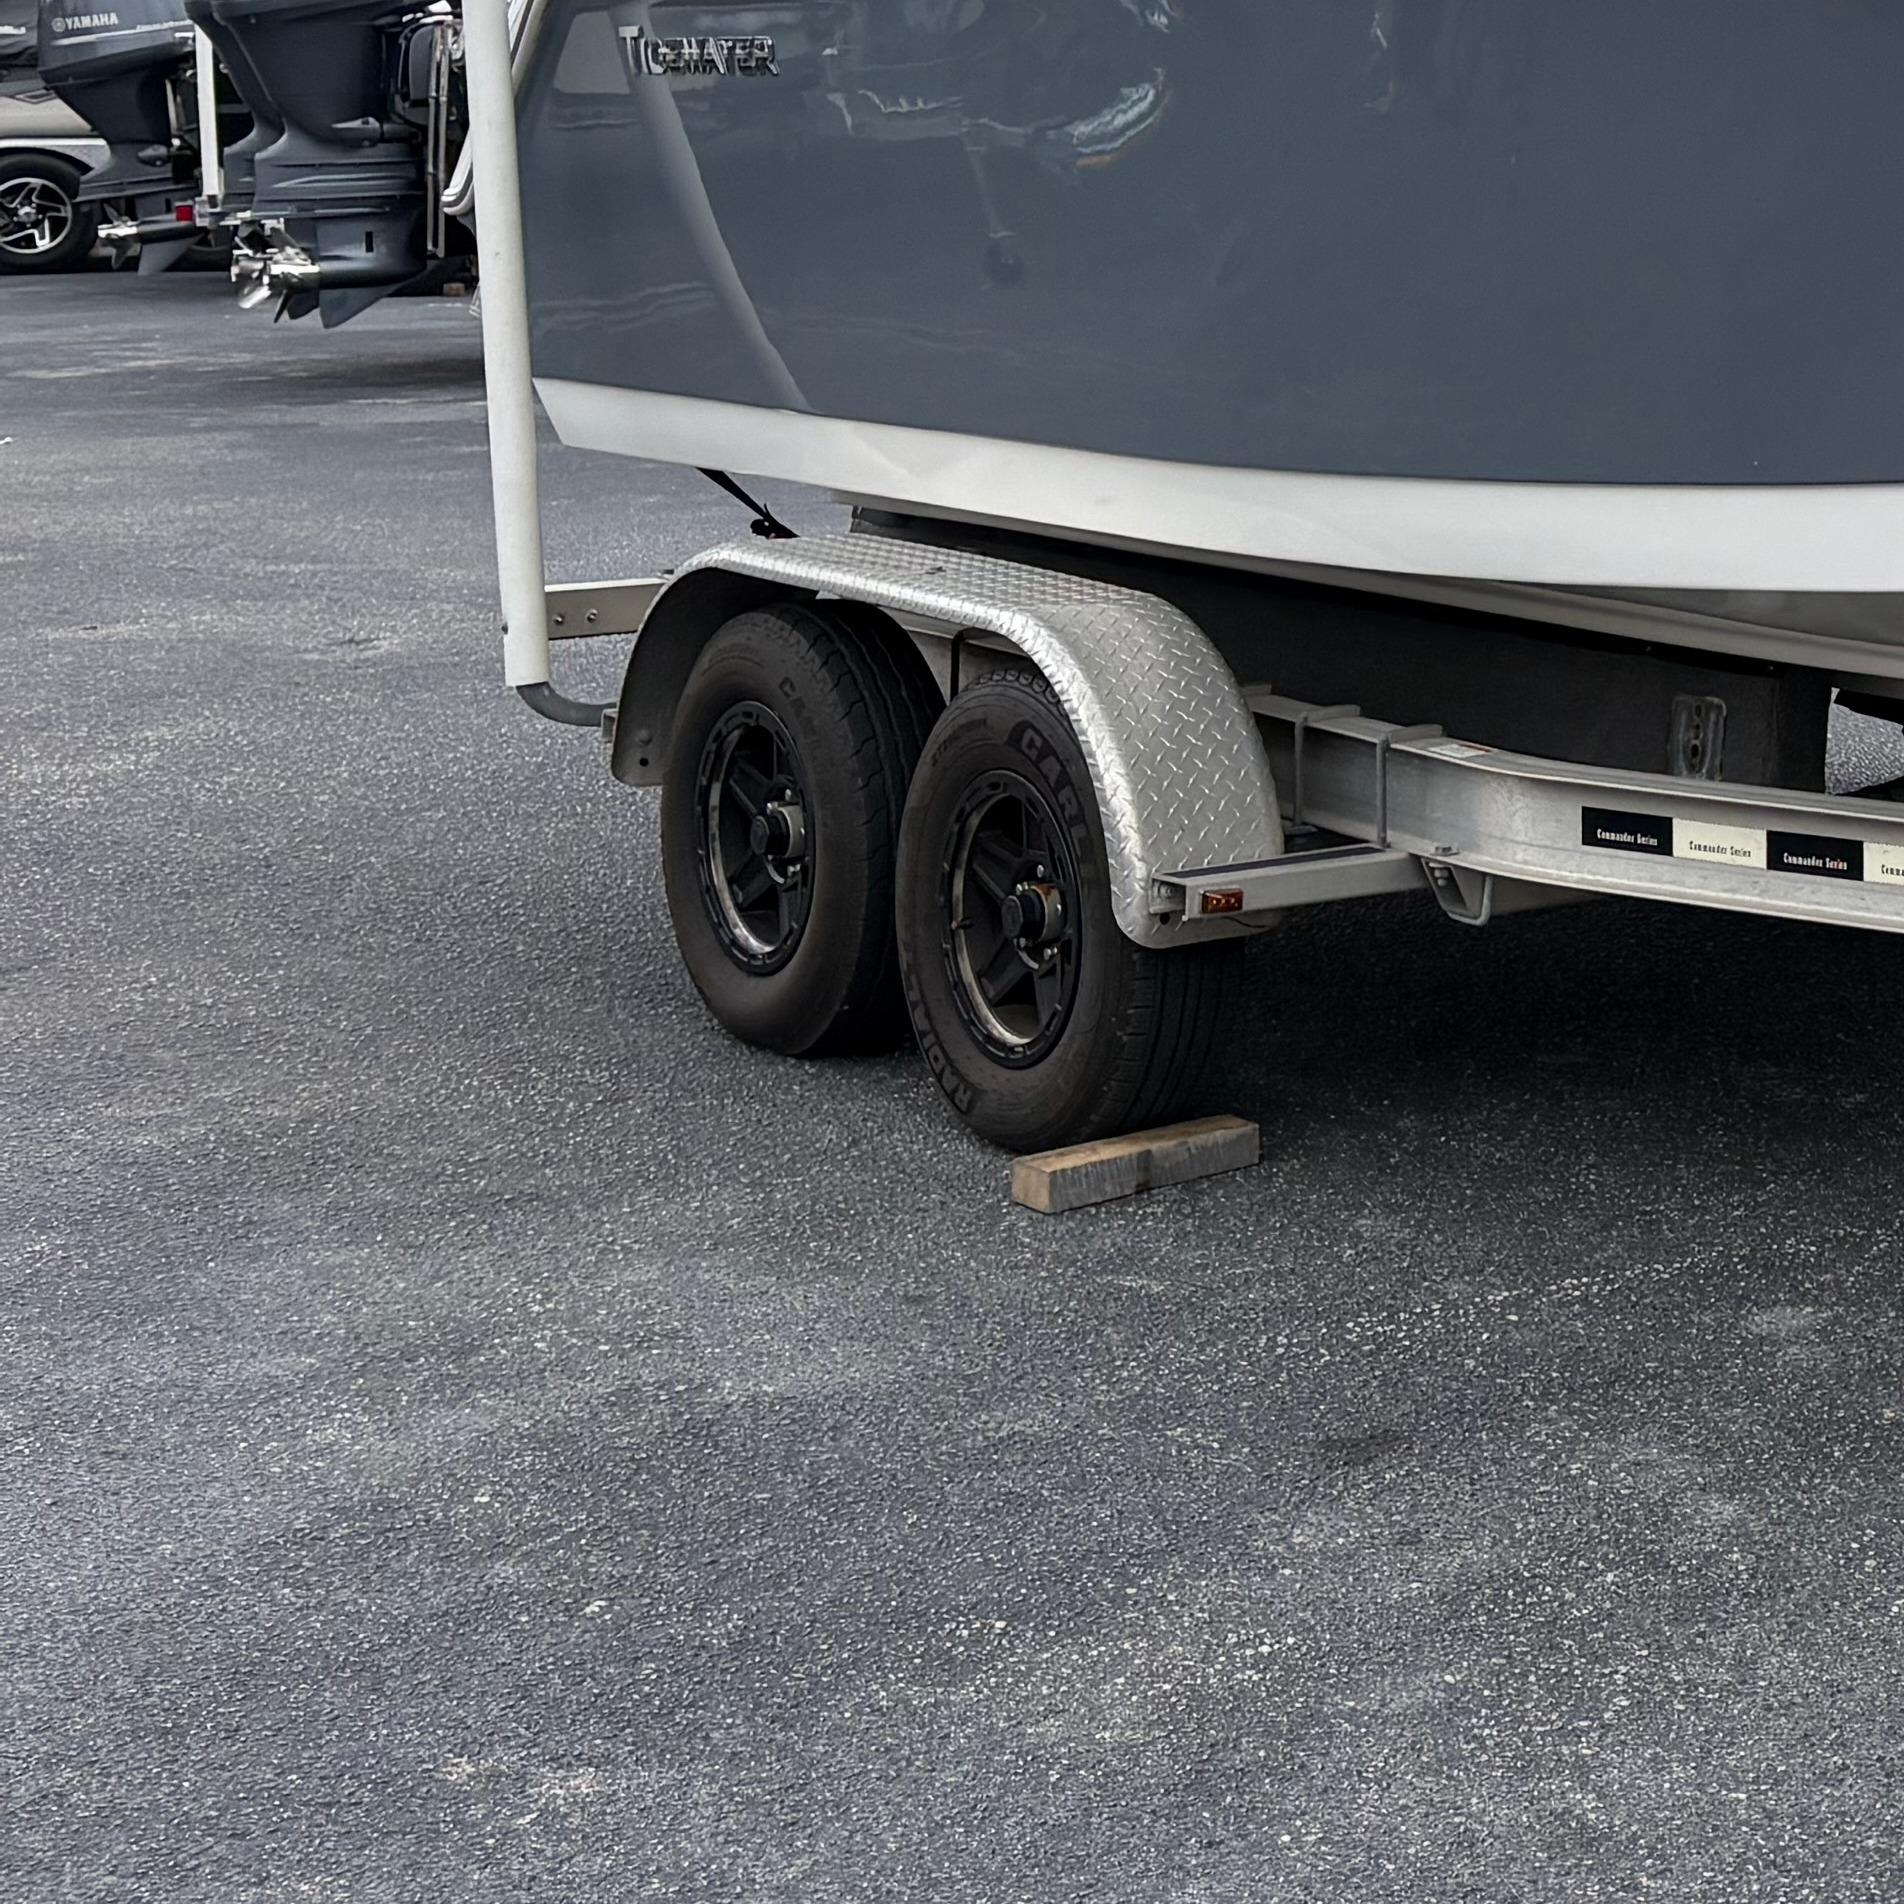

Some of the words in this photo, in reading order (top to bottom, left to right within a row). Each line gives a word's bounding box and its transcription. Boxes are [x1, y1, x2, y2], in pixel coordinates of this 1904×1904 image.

[66, 12, 119, 30] YAMAHA
[1597, 828, 1634, 843] Commander
[1689, 841, 1727, 855] Commander
[1783, 852, 1823, 868] Commander
